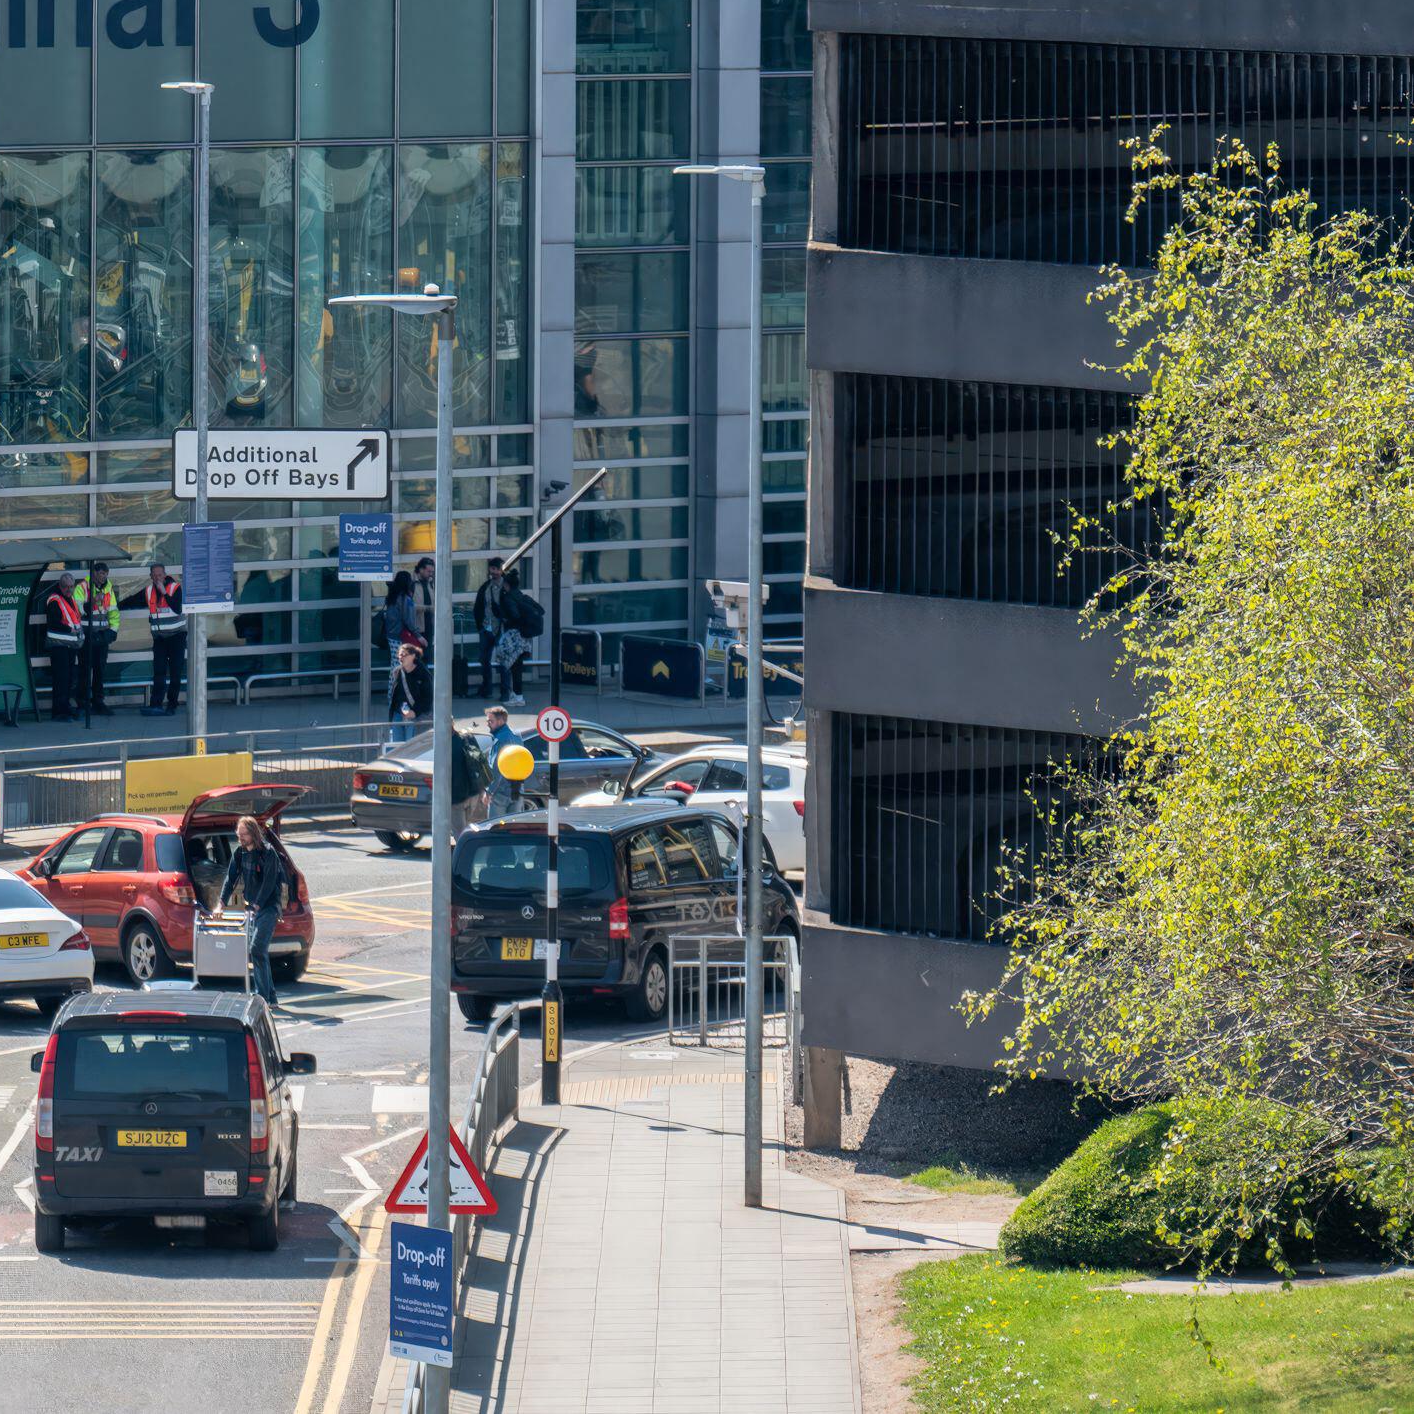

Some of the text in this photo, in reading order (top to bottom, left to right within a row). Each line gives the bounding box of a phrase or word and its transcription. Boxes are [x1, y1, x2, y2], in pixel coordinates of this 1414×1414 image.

[207, 446, 318, 463] Additional
[185, 468, 339, 489] Dop Off Bays
[345, 522, 387, 535] Drop-off
[563, 661, 597, 677] Trolleys
[544, 717, 565, 732] 10
[8, 936, 20, 947] C3
[548, 1006, 556, 1057] 3307A
[125, 1133, 180, 1145] SJ12 UZC
[55, 1146, 104, 1162] TAXI
[217, 1178, 237, 1186] 0456
[397, 1241, 445, 1268] Drop-off
[402, 1272, 440, 1292] Tariffs apply
